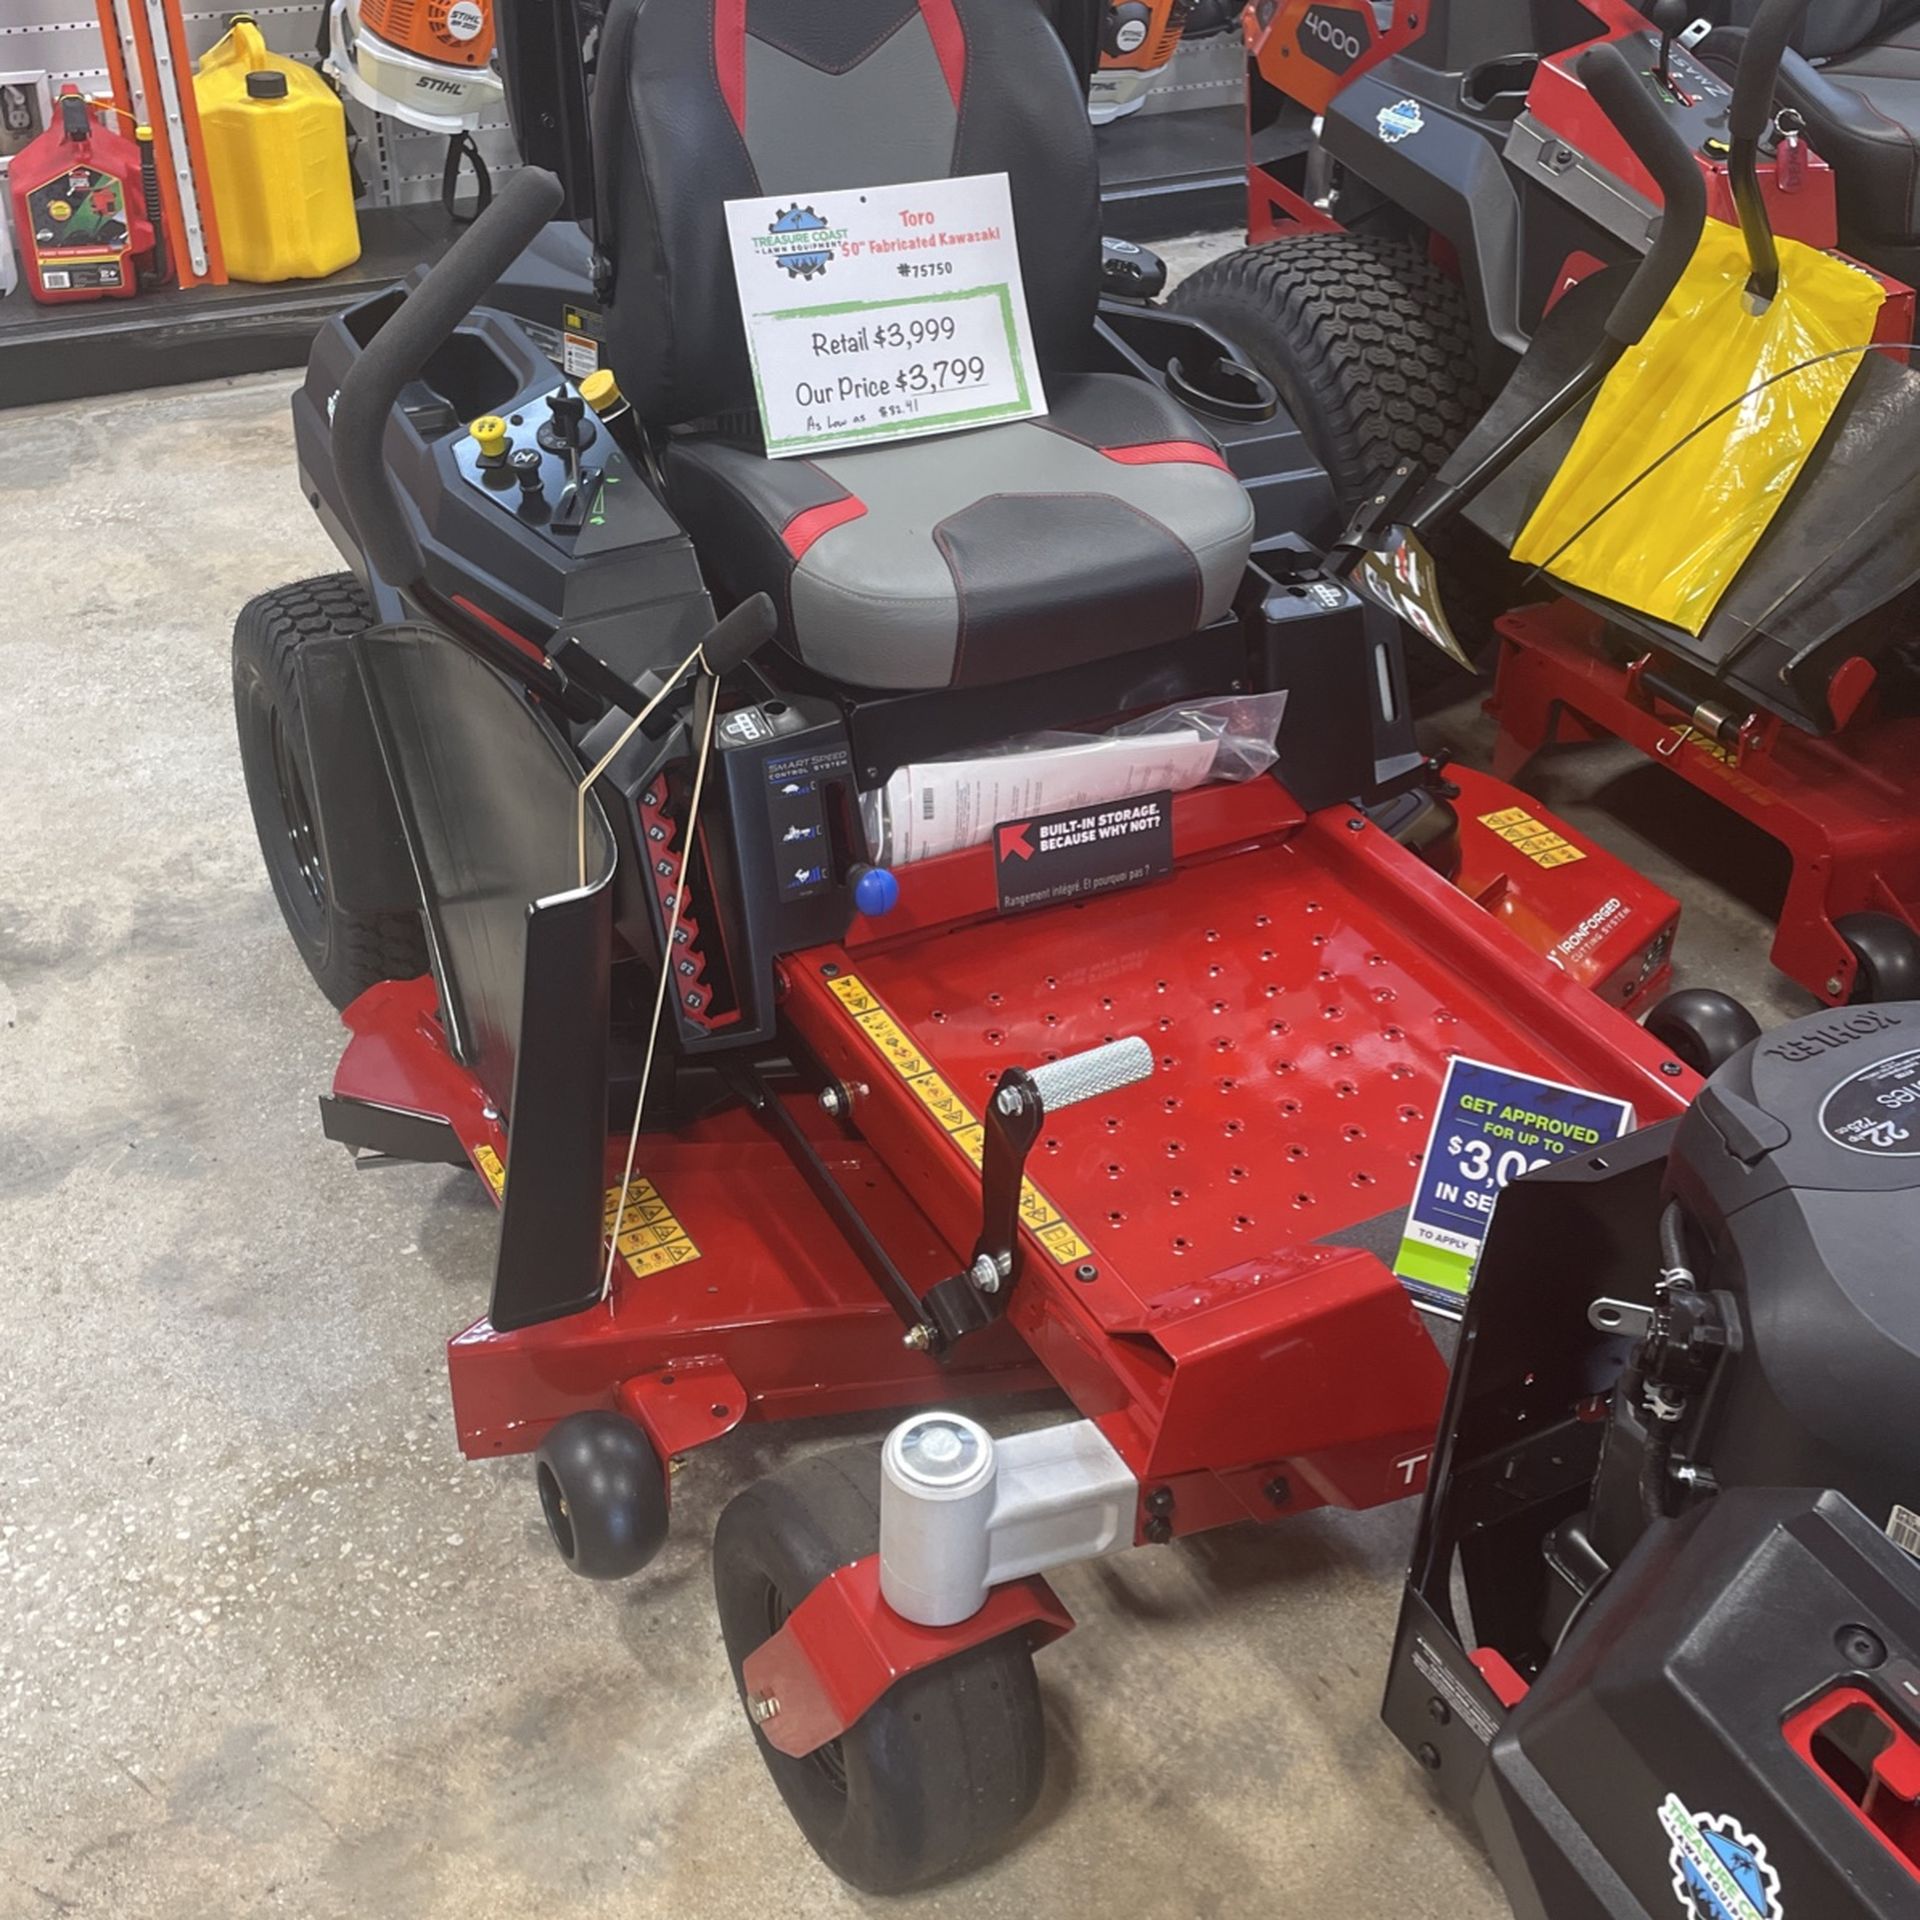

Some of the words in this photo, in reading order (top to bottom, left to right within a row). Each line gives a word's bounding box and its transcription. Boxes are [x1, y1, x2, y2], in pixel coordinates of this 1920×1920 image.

[450, 10, 480, 25] STIHL
[1304, 12, 1360, 59] 4000
[416, 76, 463, 96] STIHL
[898, 209, 935, 228] Toro
[751, 232, 810, 248] TREASURE
[811, 228, 849, 242] COAST
[761, 243, 788, 255] LAWN
[869, 234, 937, 254] Fabricated
[896, 261, 953, 279] #75750
[811, 326, 870, 357] Retail
[873, 316, 955, 350] $3,999
[795, 382, 834, 407] Our
[837, 376, 891, 401] Price
[895, 356, 985, 395] $3,799
[806, 415, 823, 432] As
[827, 416, 848, 430] Low
[853, 413, 867, 424] as
[768, 758, 810, 774] SMART
[810, 751, 847, 766] SPEED
[768, 768, 809, 781] CONTROL
[813, 760, 848, 772] SYSTEM
[1039, 817, 1097, 839] BUILT-IN
[1098, 803, 1161, 827] STORAGE.
[1039, 831, 1097, 853] BECAUSE
[1099, 823, 1128, 839] WHY
[1129, 816, 1162, 833] NOT?
[1003, 887, 1050, 908] Rangement
[1093, 870, 1128, 890] pourquoi
[1128, 867, 1144, 882] pas
[1570, 932, 1604, 963] CUTTING
[1600, 906, 1632, 936] SYSTEM
[1763, 1011, 1902, 1062] KOHLER
[1459, 1094, 1498, 1116] GET
[1499, 1106, 1600, 1145] APPROVED
[1483, 1122, 1514, 1141] FOR
[1517, 1131, 1540, 1147] UP
[1543, 1138, 1565, 1155] TO
[1434, 1181, 1459, 1204] IN
[1418, 1227, 1434, 1241] TO
[1434, 1233, 1469, 1251] APPLY
[1669, 1800, 1741, 1901] TREASURE
[1670, 1824, 1702, 1866] LAWN
